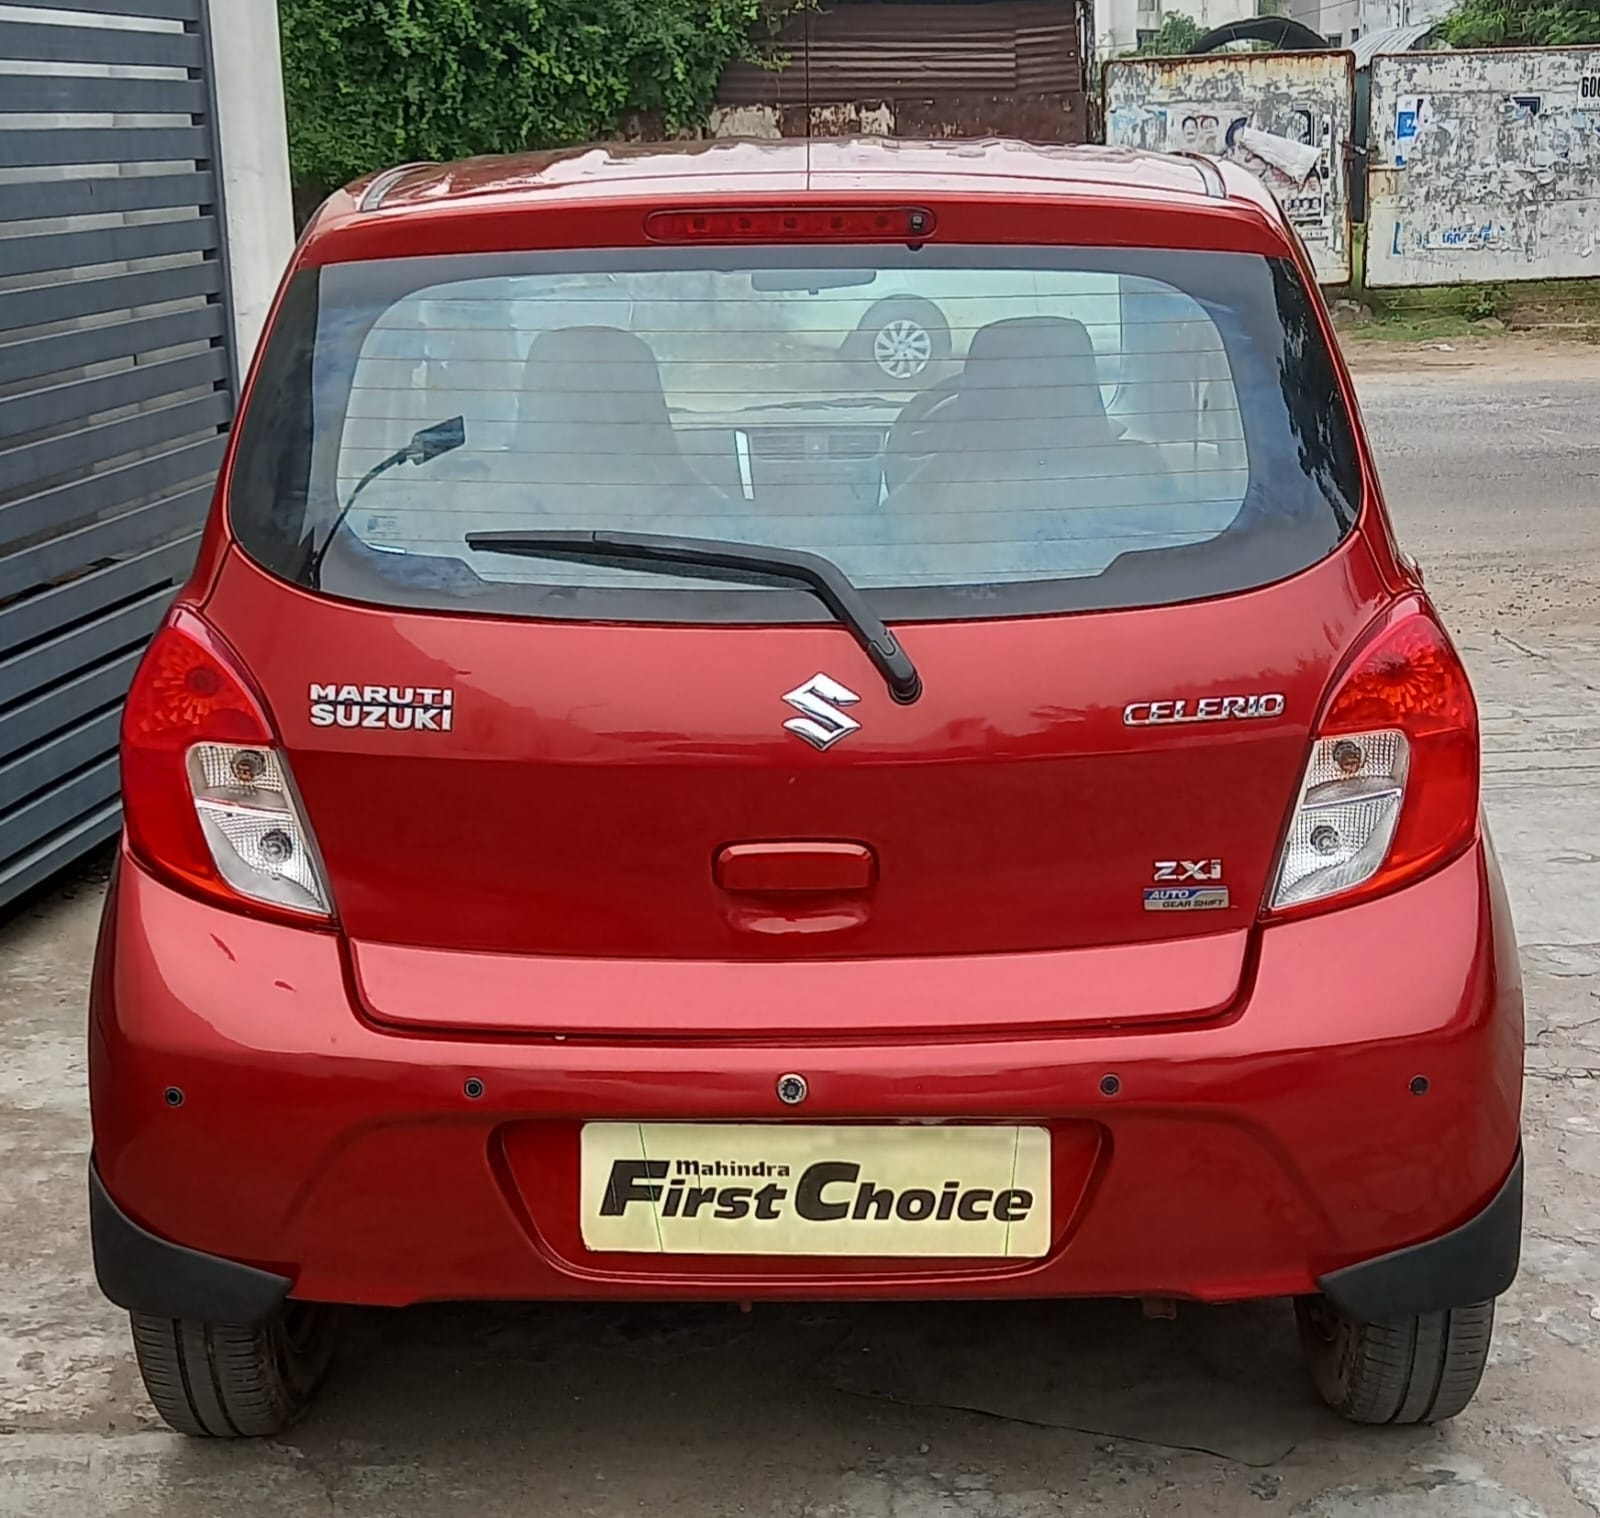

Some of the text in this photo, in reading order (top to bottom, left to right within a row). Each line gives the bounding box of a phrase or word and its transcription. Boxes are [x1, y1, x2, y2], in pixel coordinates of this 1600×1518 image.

[309, 683, 453, 706] MARUTI
[310, 703, 452, 731] SUZUKI
[1123, 693, 1285, 726] CELERIO
[1149, 889, 1190, 900] AUTO
[1162, 899, 1225, 908] GEAR SHIFT
[599, 1160, 1034, 1222] First Choice
